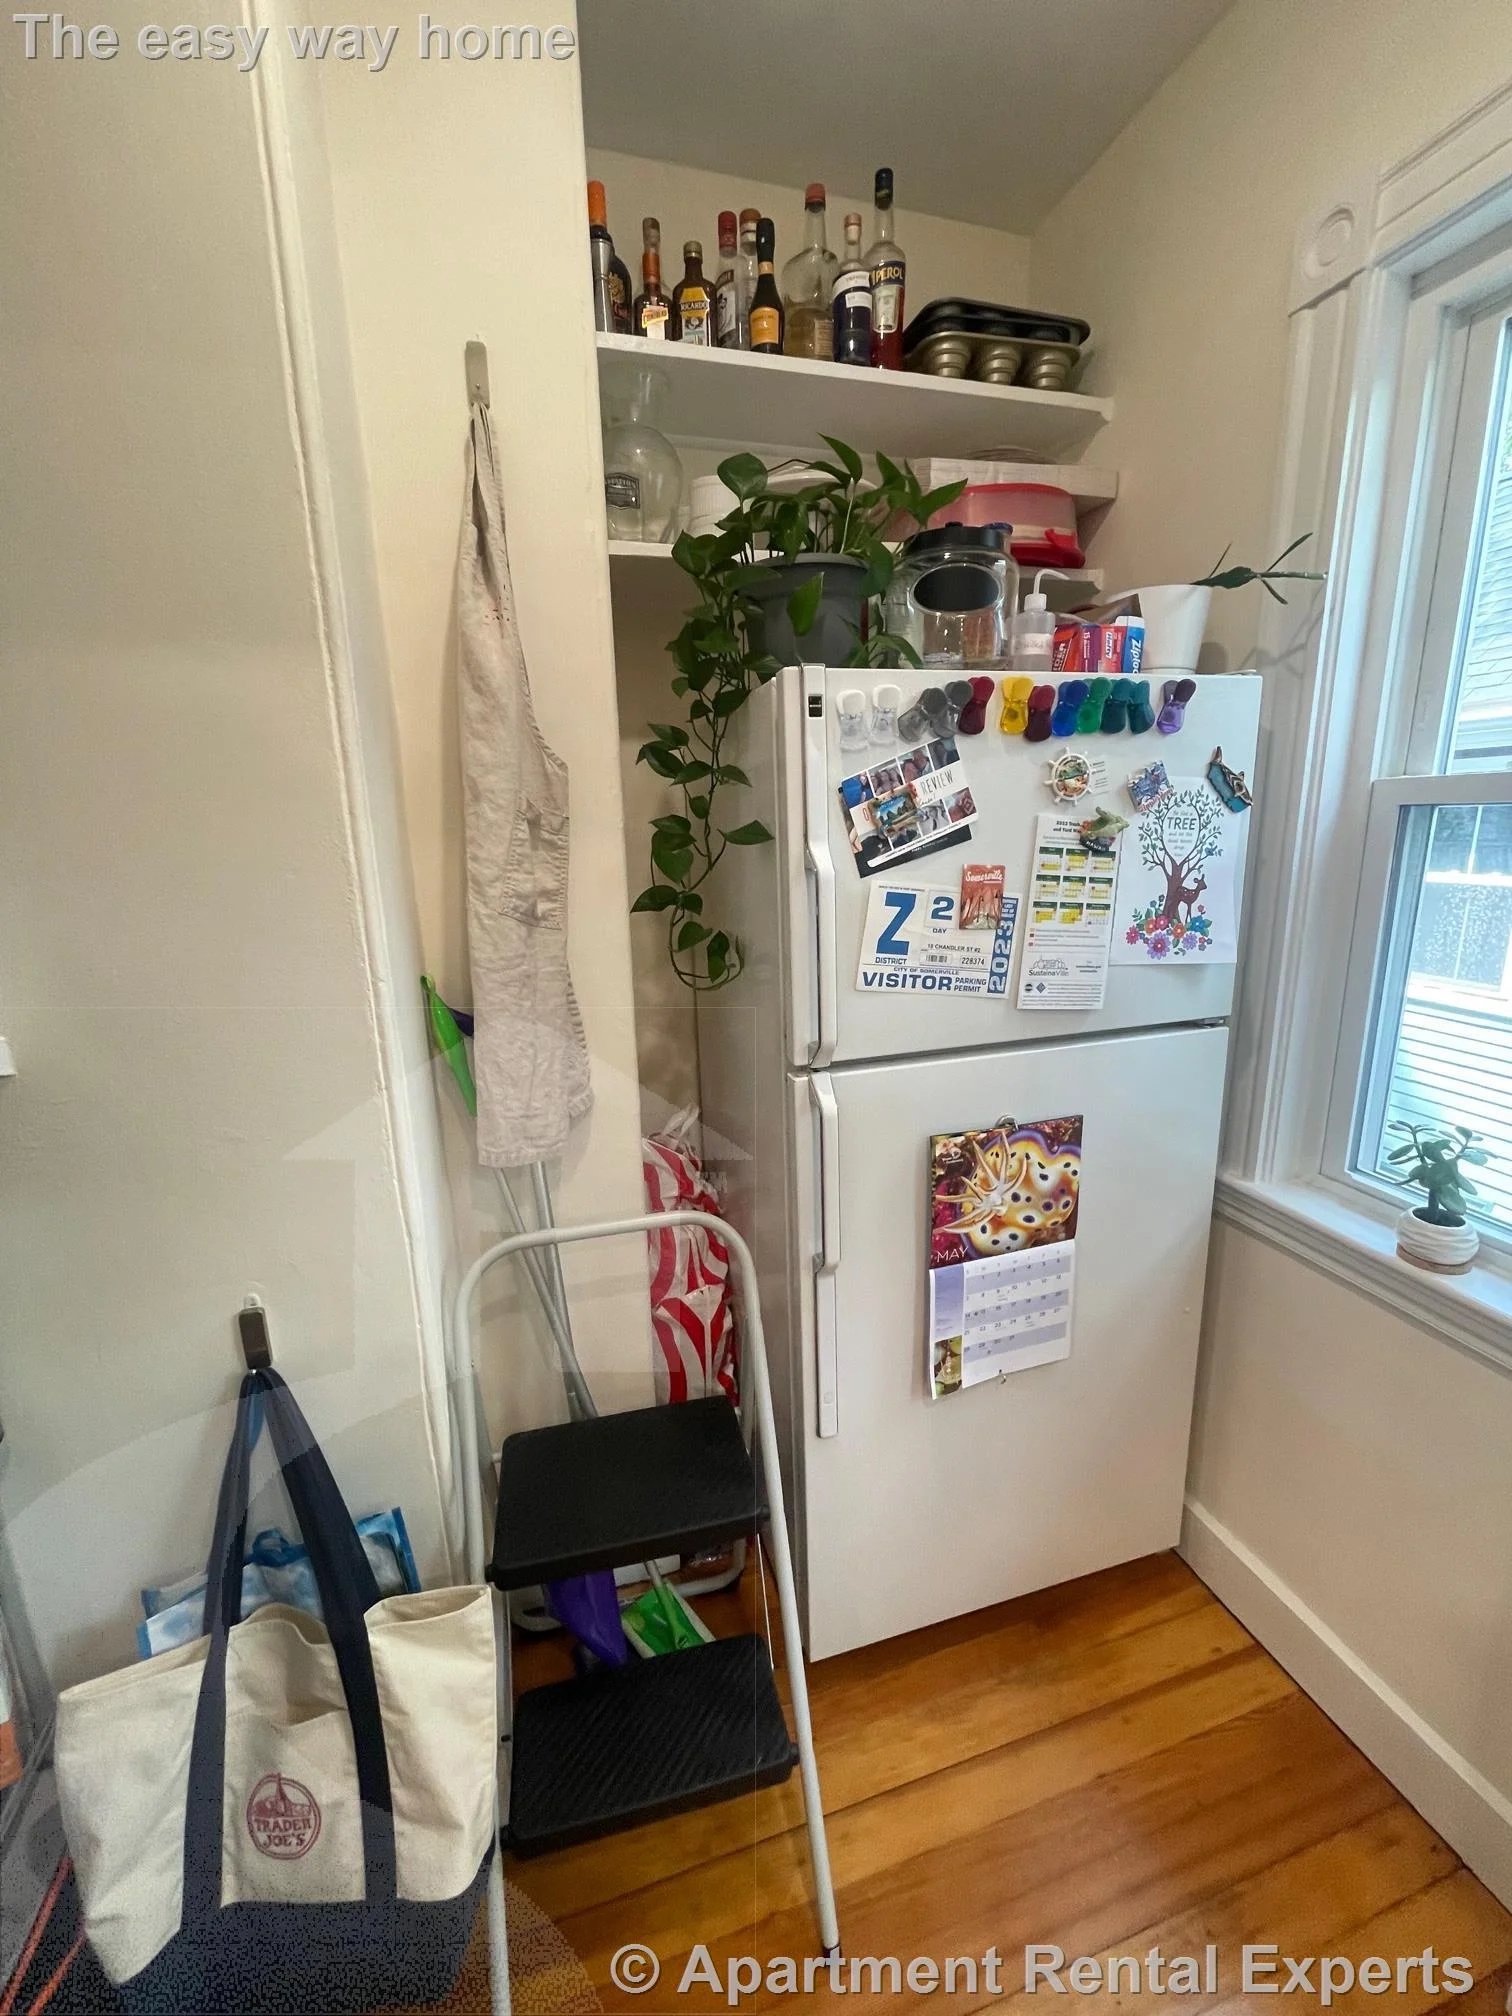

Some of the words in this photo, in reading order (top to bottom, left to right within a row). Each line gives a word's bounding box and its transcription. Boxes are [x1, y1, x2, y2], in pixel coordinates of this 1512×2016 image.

[1166, 816, 1198, 831] TREE
[930, 896, 955, 920] 2
[876, 891, 917, 956] Z
[934, 944, 966, 952] CHANDLER
[875, 956, 908, 966] DISTRICT
[862, 971, 953, 991] VISITOR
[954, 976, 987, 986] PARKING
[953, 985, 982, 993] PERMIT
[936, 1247, 969, 1263] MAY
[254, 1818, 312, 1832] TRADER
[262, 1833, 306, 1849] JOE'S
